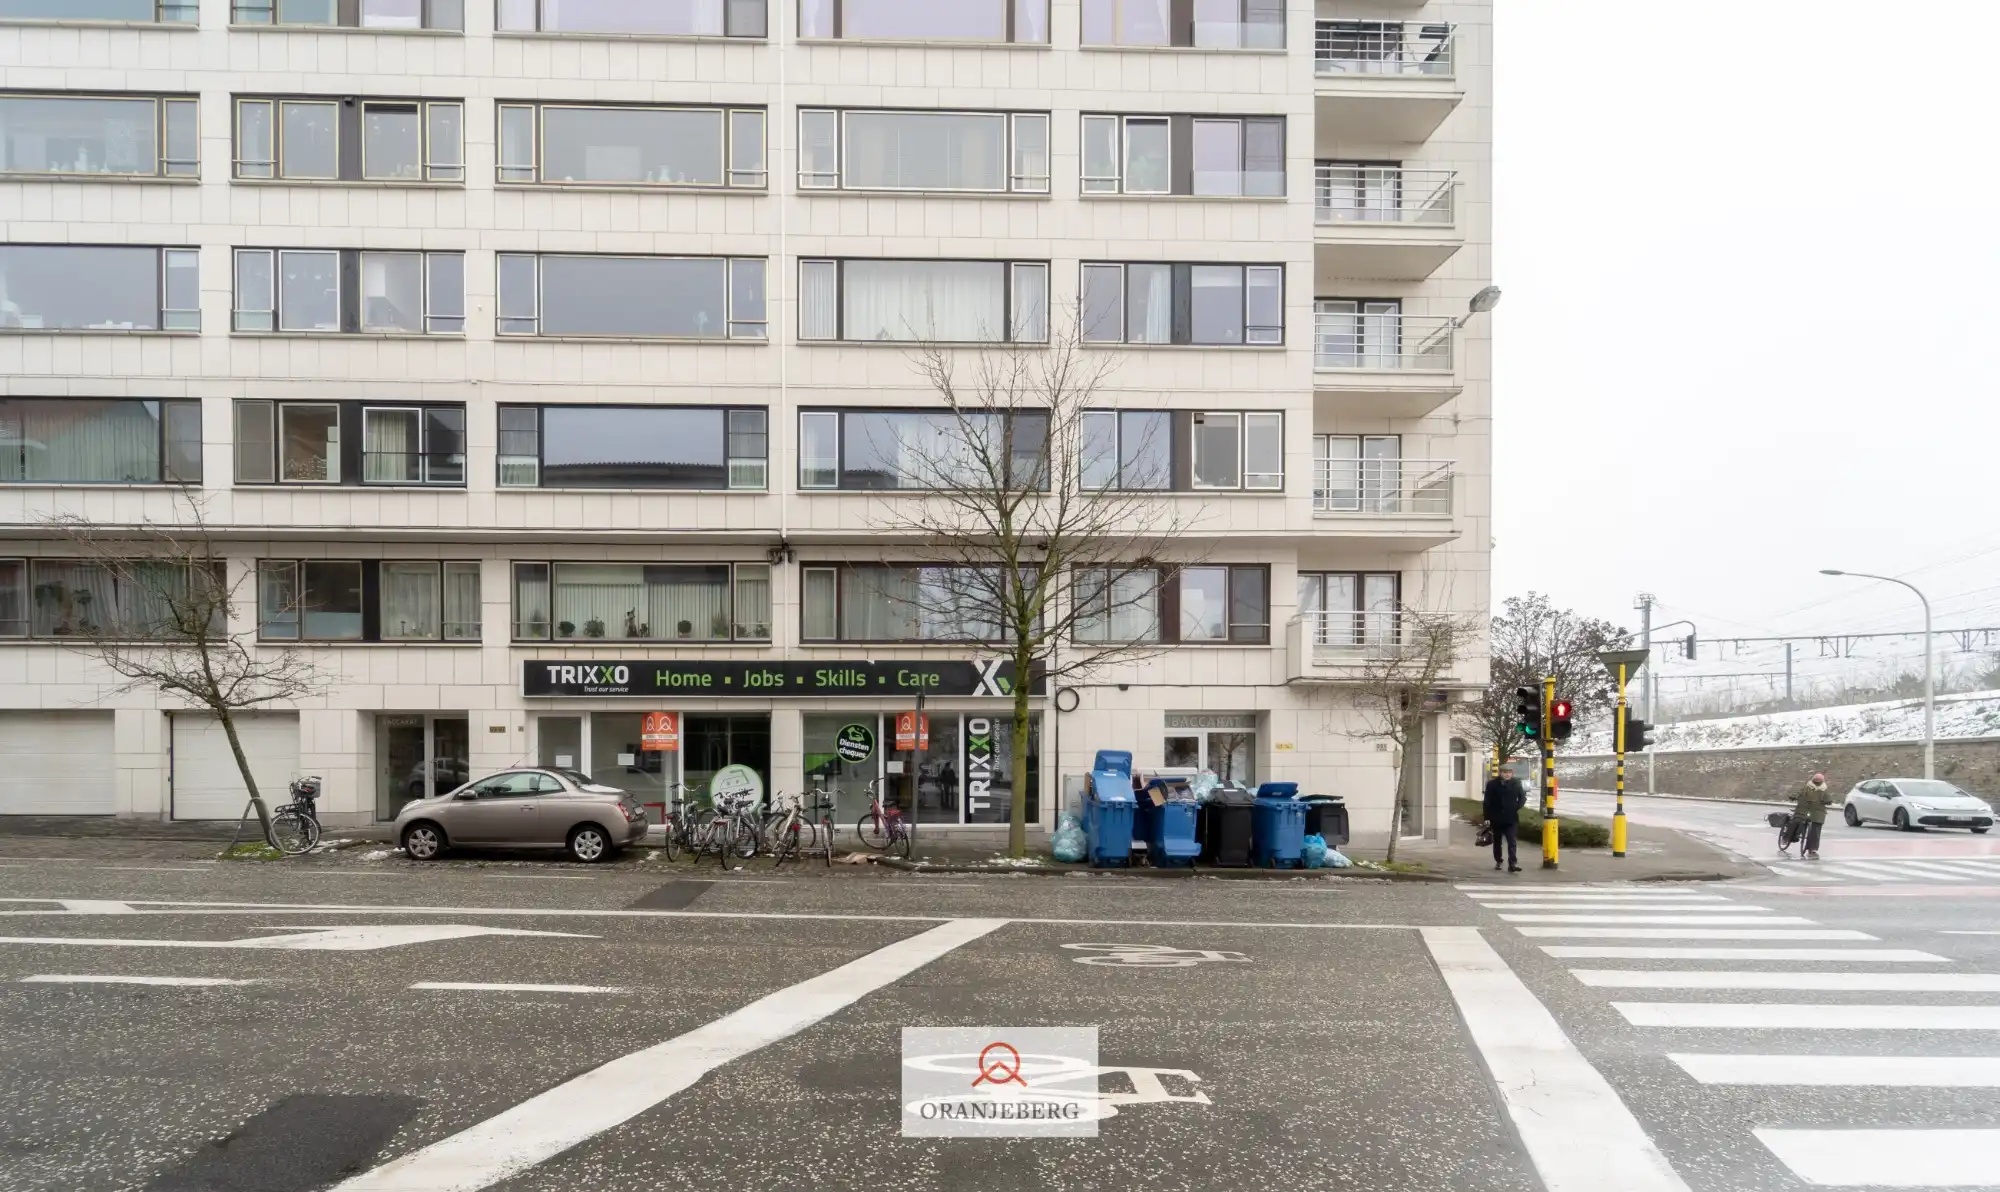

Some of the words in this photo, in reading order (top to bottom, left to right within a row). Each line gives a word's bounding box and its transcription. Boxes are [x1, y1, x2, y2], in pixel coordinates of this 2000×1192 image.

[547, 665, 629, 684] TRIXXO
[656, 669, 712, 687] Home
[743, 669, 785, 688] Jobs
[815, 669, 867, 687] Skills
[897, 670, 940, 687] Care
[1171, 716, 1240, 728] BACCARAT
[839, 738, 870, 751] Diensten
[839, 747, 867, 759] cheques
[969, 718, 991, 814] TRIXXO
